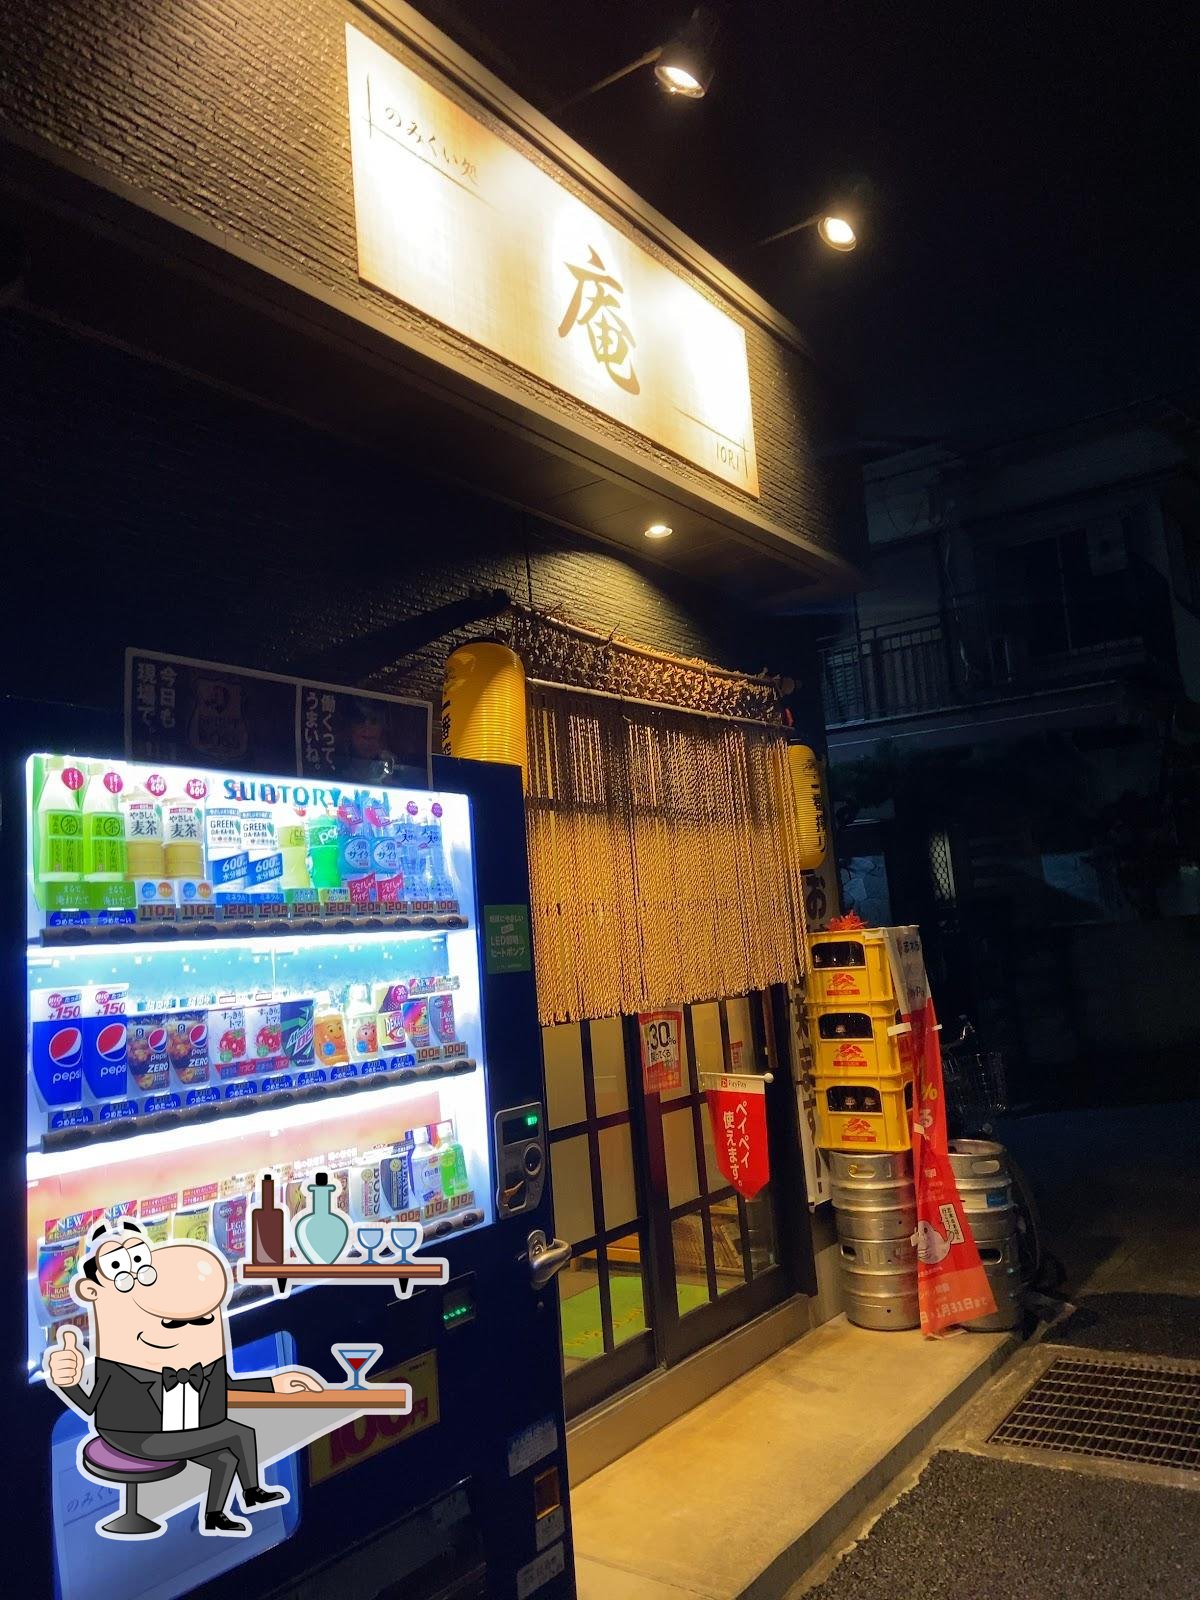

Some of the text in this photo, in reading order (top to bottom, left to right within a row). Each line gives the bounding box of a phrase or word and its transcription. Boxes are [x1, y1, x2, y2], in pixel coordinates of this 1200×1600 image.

[384, 105, 479, 186] のみくい処
[558, 245, 641, 395] 庵
[715, 440, 741, 473] IORI
[160, 666, 176, 728] 今日も
[305, 692, 320, 770] うまいね。
[224, 778, 342, 808] SUNTORY
[131, 820, 158, 836] 麦茶
[171, 823, 198, 839] 麦茶
[210, 820, 234, 829] GREEN
[243, 823, 267, 832] GREEN
[147, 1063, 169, 1073] ZERO
[188, 1057, 209, 1068] ZERO
[735, 1100, 750, 1169] ペイペイ
[723, 1111, 743, 1187] 使えます。
[57, 1214, 85, 1230] NEW
[104, 1202, 130, 1219] NEW
